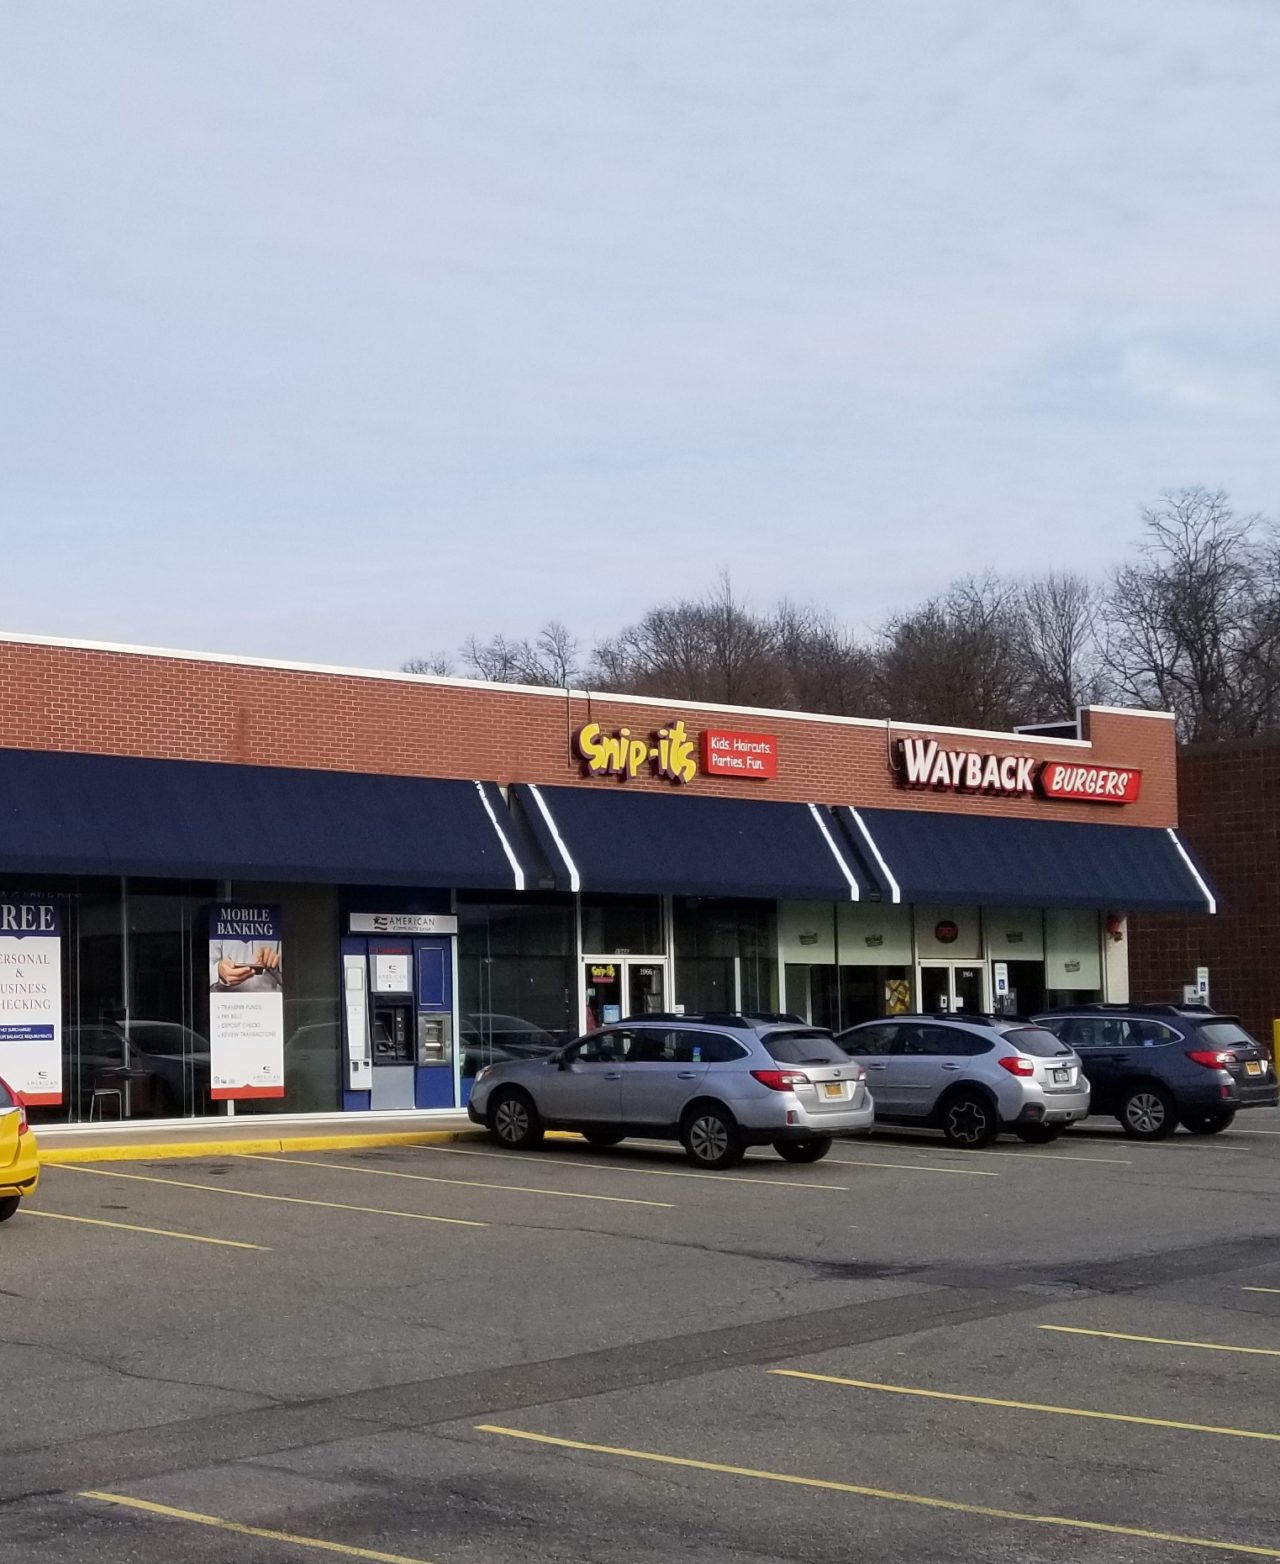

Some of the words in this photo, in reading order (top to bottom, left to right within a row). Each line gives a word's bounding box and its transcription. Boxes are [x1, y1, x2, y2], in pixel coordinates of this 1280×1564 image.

[579, 720, 697, 783] Snip-its
[711, 736, 731, 750] Kids.
[733, 738, 772, 754] Haircuts.
[712, 752, 745, 768] Parties.
[746, 756, 765, 770] Fun.
[903, 738, 1035, 792] WAYBACK
[1052, 766, 1127, 796] BURGERS
[220, 908, 270, 921] MOBILE
[390, 917, 435, 926] AMERICAN
[217, 922, 273, 936] BANKING
[15, 968, 24, 978] &
